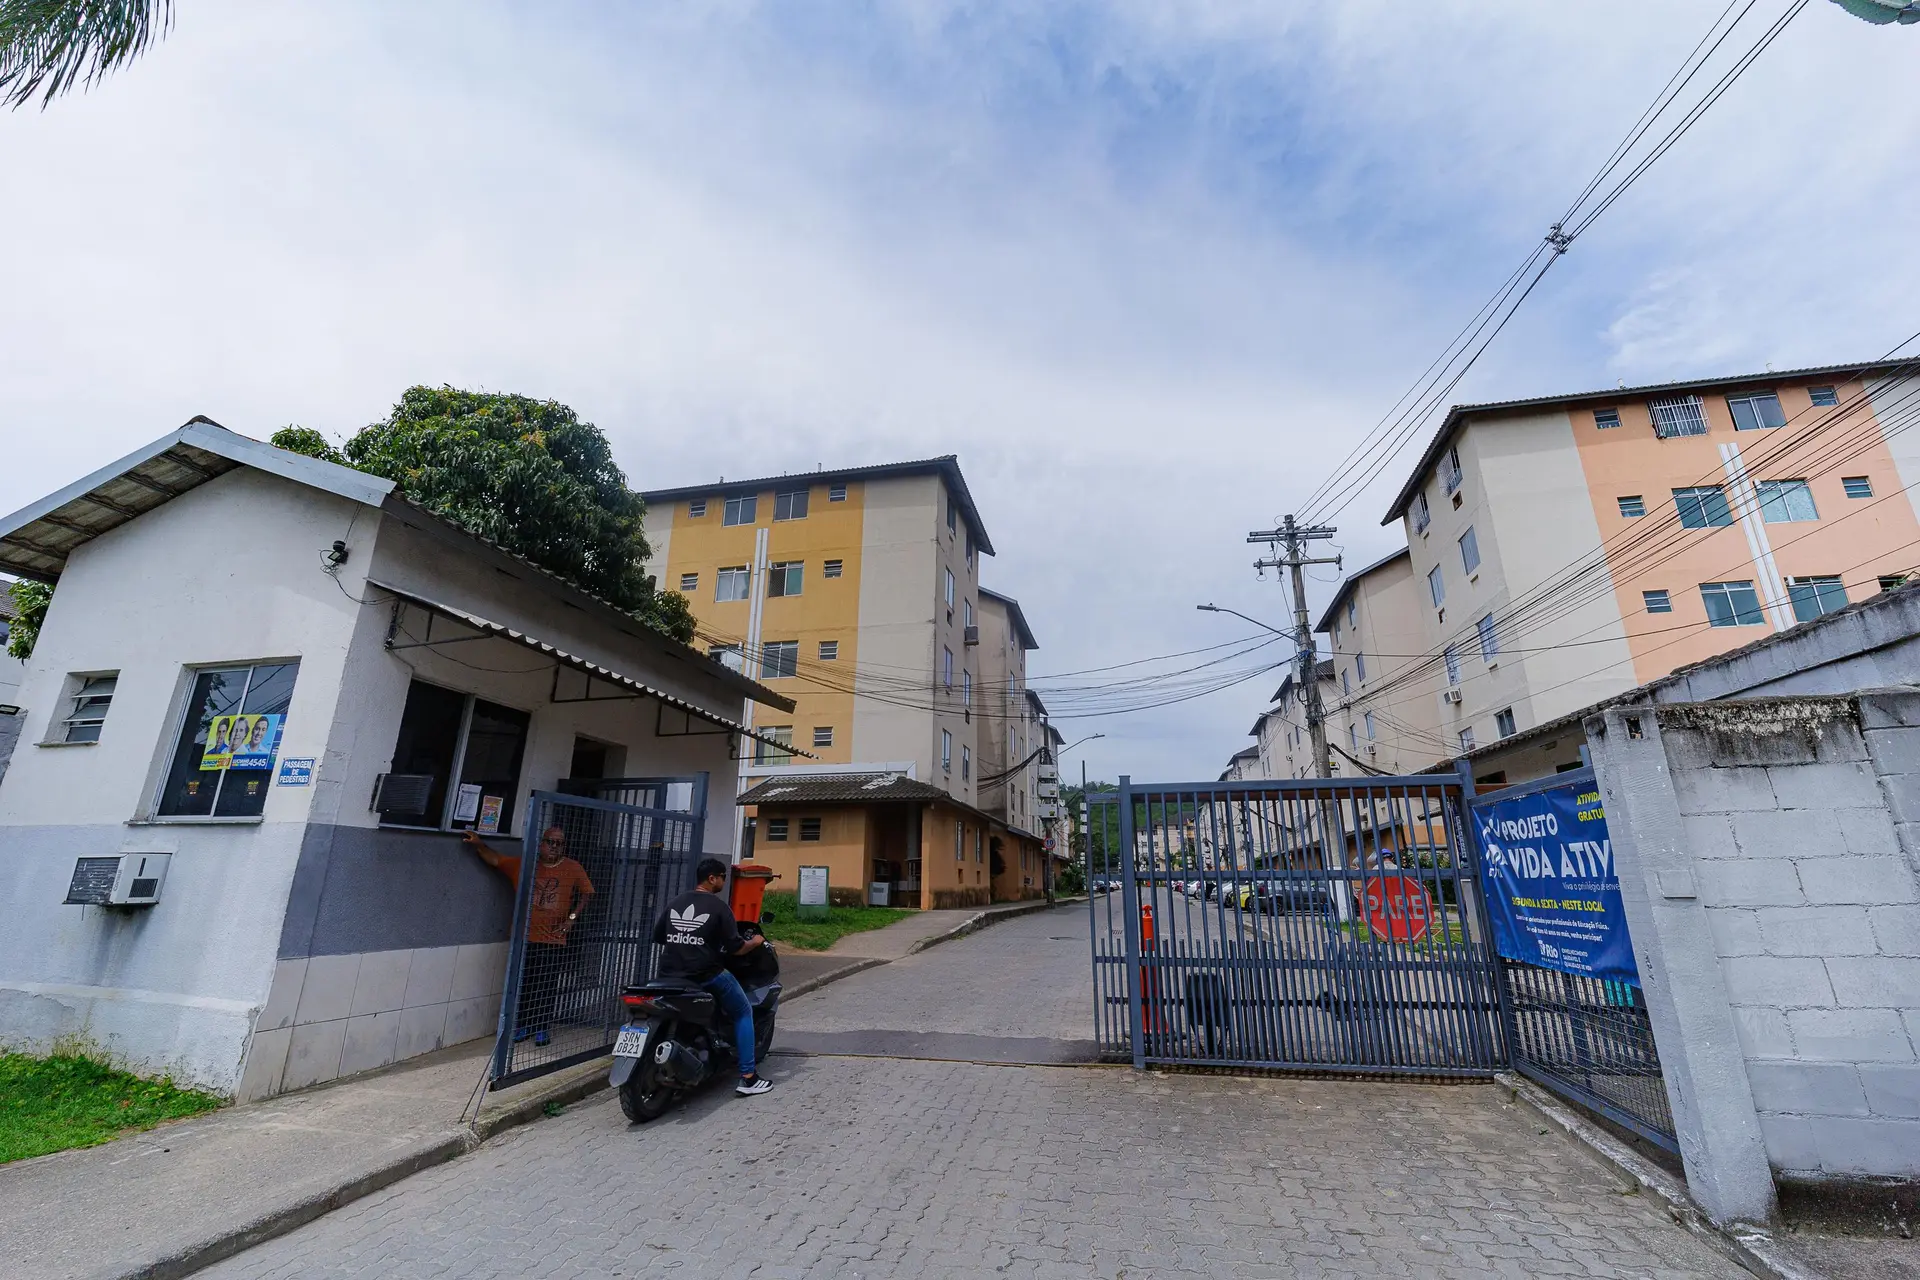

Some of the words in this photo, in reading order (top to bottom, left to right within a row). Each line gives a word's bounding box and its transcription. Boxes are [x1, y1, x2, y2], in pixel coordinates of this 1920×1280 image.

[247, 758, 267, 767] 4545
[283, 760, 313, 769] PASSAGEM
[279, 775, 309, 783] PEDESTRES
[1501, 813, 1558, 841] PROJETO
[1508, 845, 1556, 879] VIDA
[1560, 840, 1618, 878] ATIV
[1367, 894, 1425, 920] PARE
[1541, 898, 1559, 909] SEXTA
[1562, 899, 1582, 911] NESTE
[1583, 901, 1605, 912] LOCAL
[666, 932, 705, 945] adidas
[623, 1032, 641, 1043] SRN
